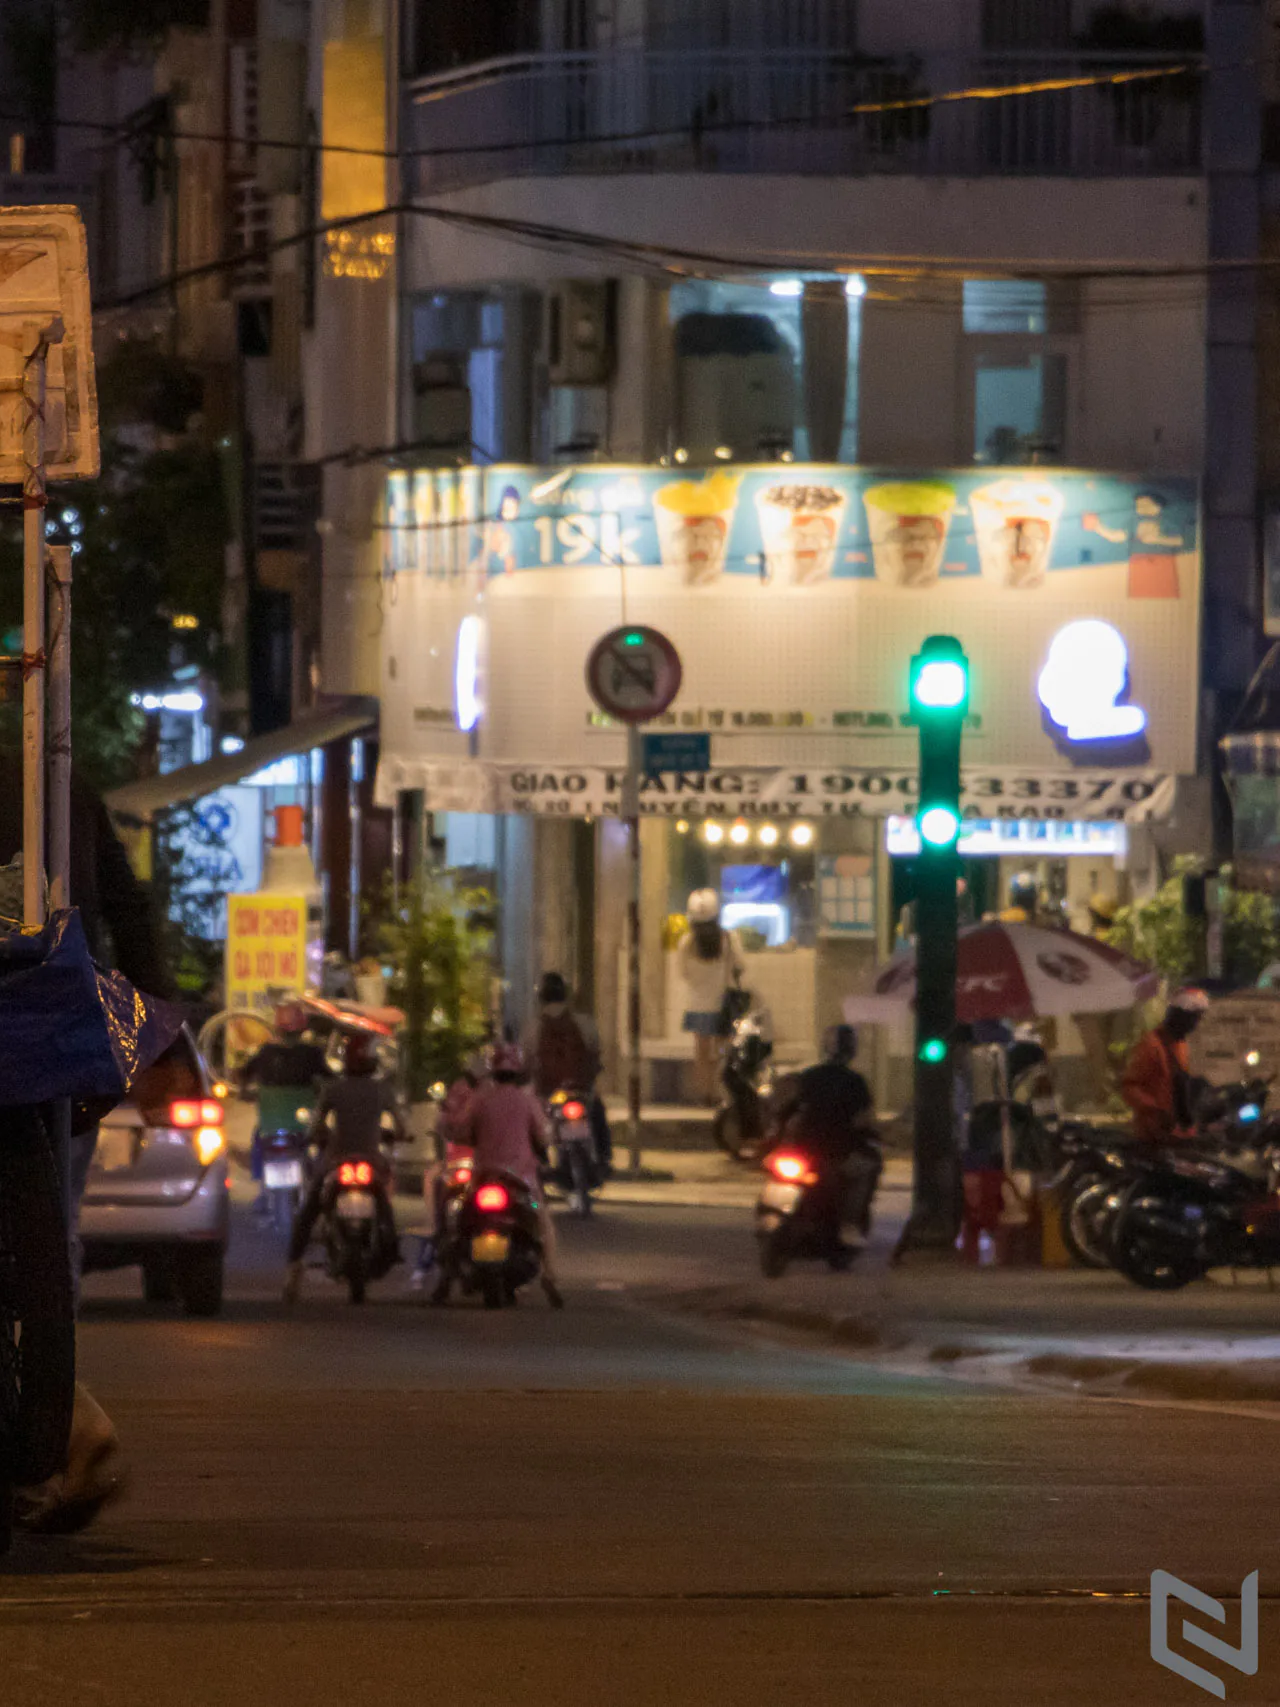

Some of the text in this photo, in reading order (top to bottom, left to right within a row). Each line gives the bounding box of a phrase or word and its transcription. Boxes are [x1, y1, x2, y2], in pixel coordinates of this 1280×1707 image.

[533, 512, 642, 565] 19k
[511, 773, 587, 794] GIAO
[788, 773, 1156, 801] 190033370
[601, 797, 725, 814] NUYỄN
